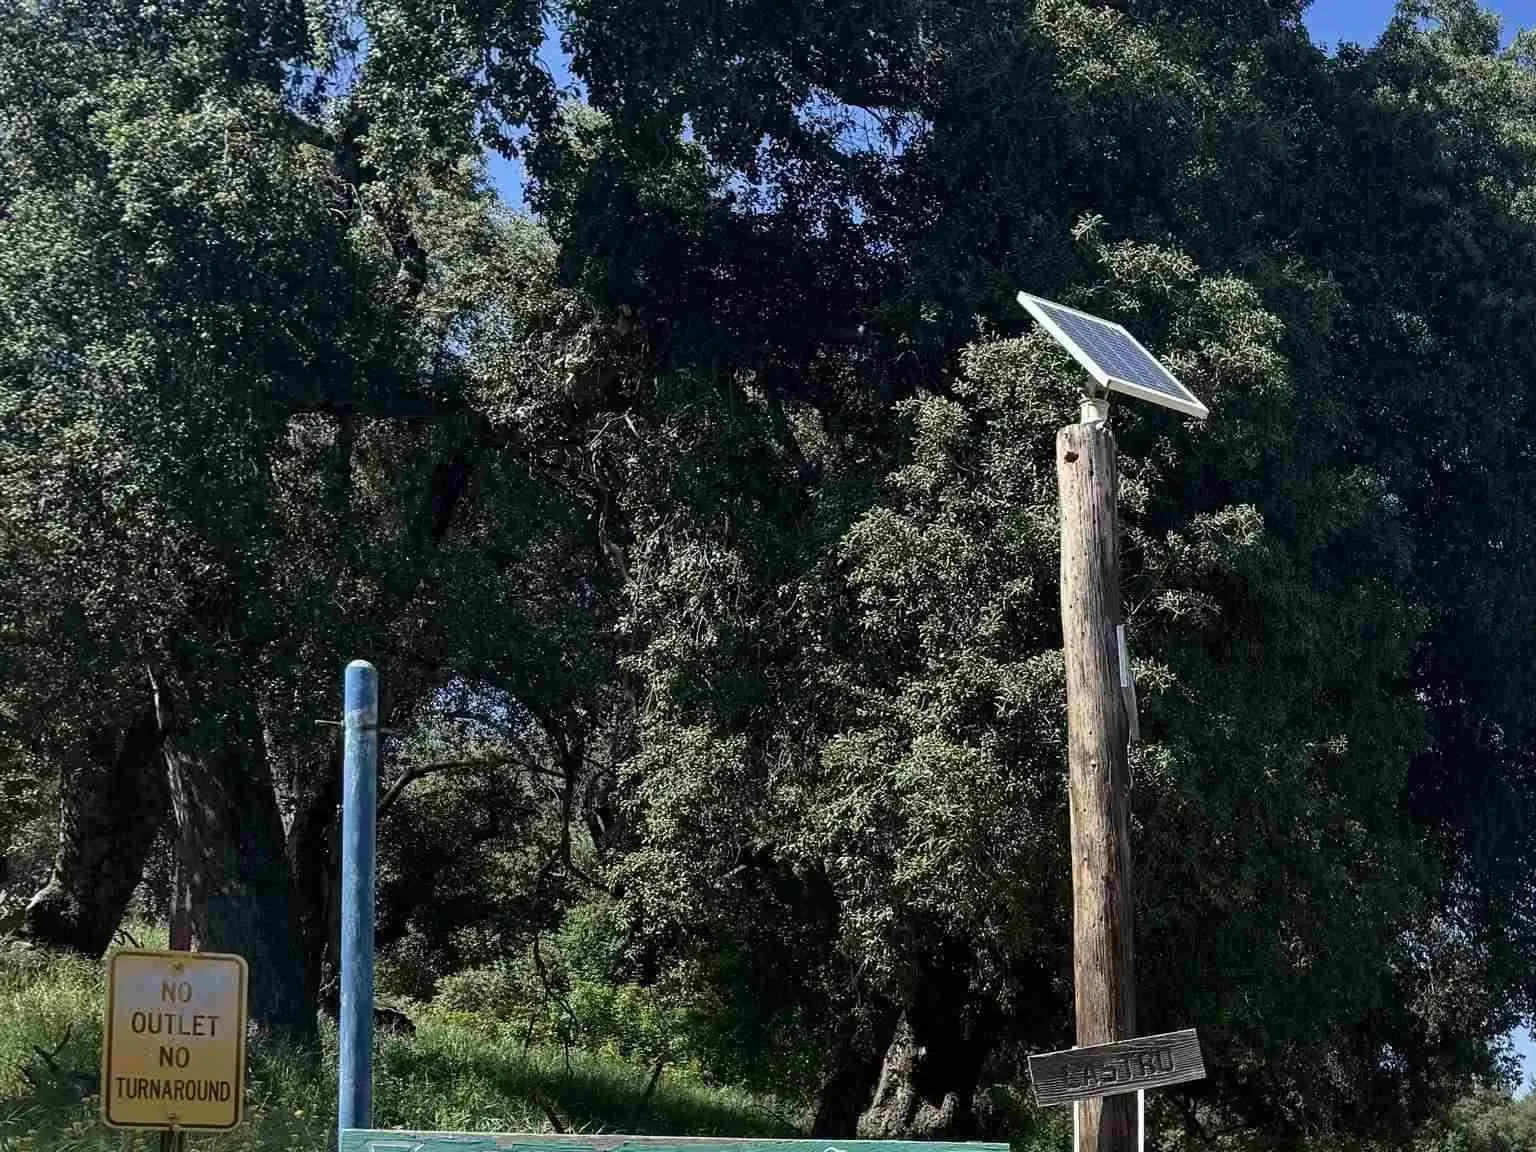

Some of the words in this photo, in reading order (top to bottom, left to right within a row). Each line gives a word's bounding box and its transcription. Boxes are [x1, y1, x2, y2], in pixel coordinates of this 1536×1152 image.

[161, 980, 193, 1003] NO
[131, 1011, 220, 1037] OUTLET
[158, 1046, 191, 1069] NO
[116, 1076, 232, 1102] TURNAROUND
